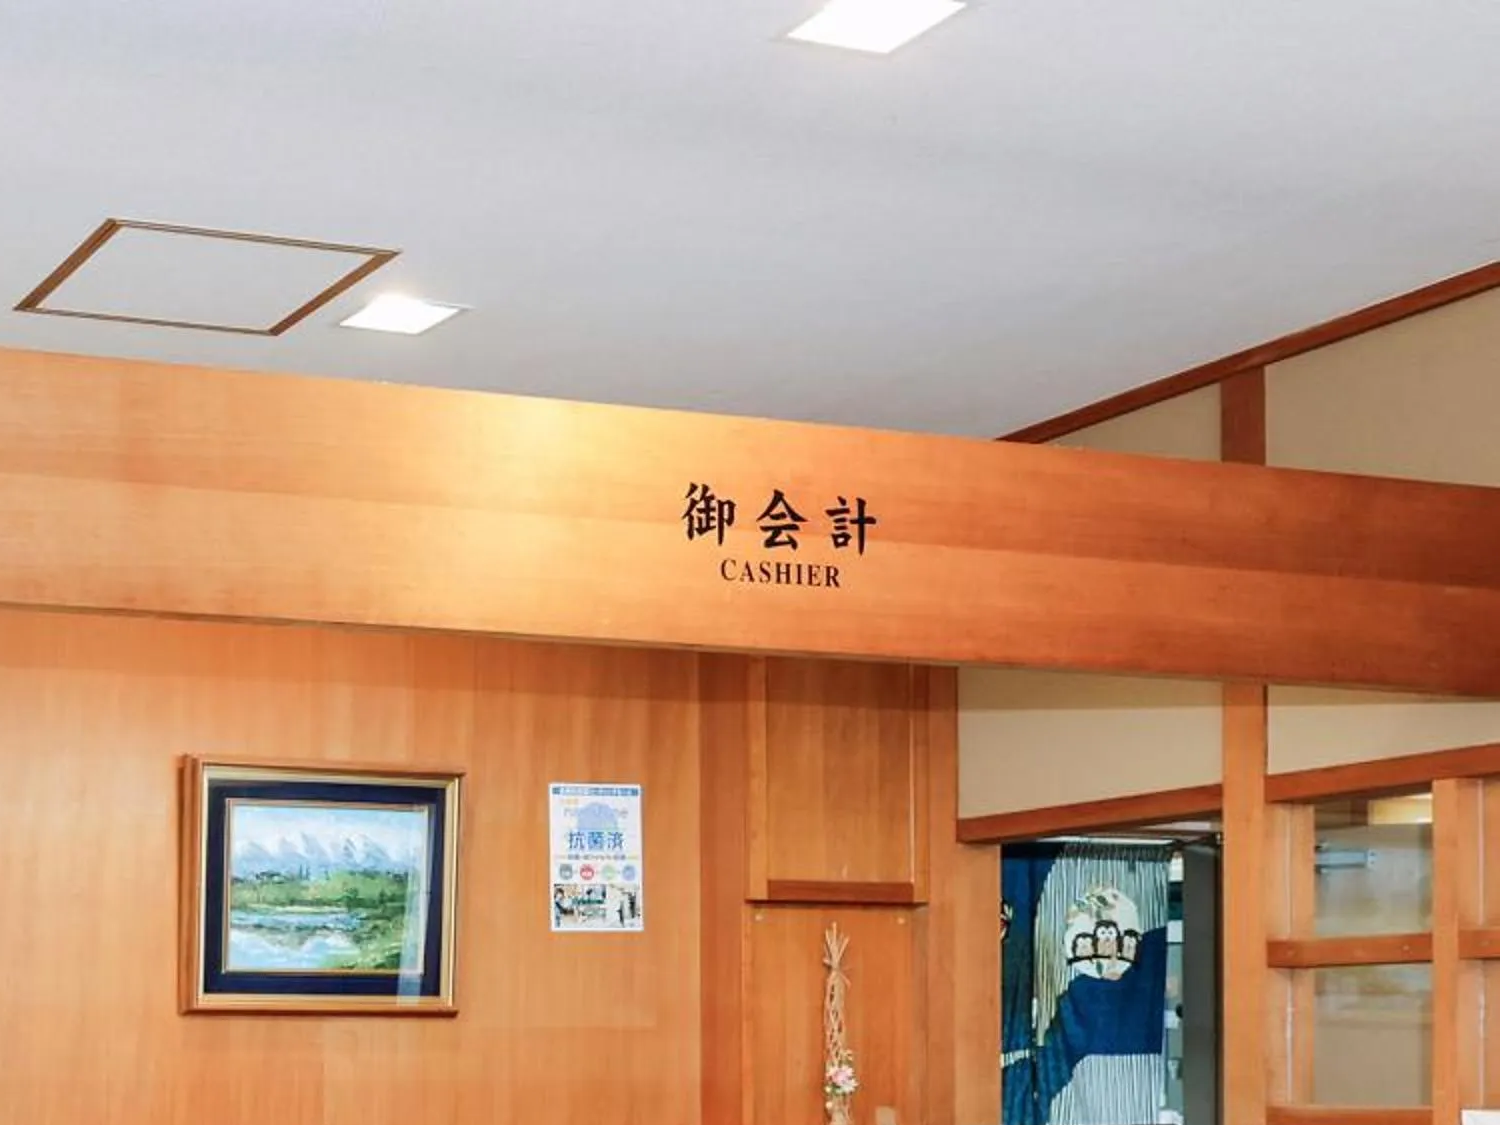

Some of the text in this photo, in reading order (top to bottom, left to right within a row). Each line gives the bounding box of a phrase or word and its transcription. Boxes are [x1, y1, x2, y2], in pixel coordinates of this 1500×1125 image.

[682, 482, 877, 556] 御会計
[719, 558, 841, 588] CASHIER
